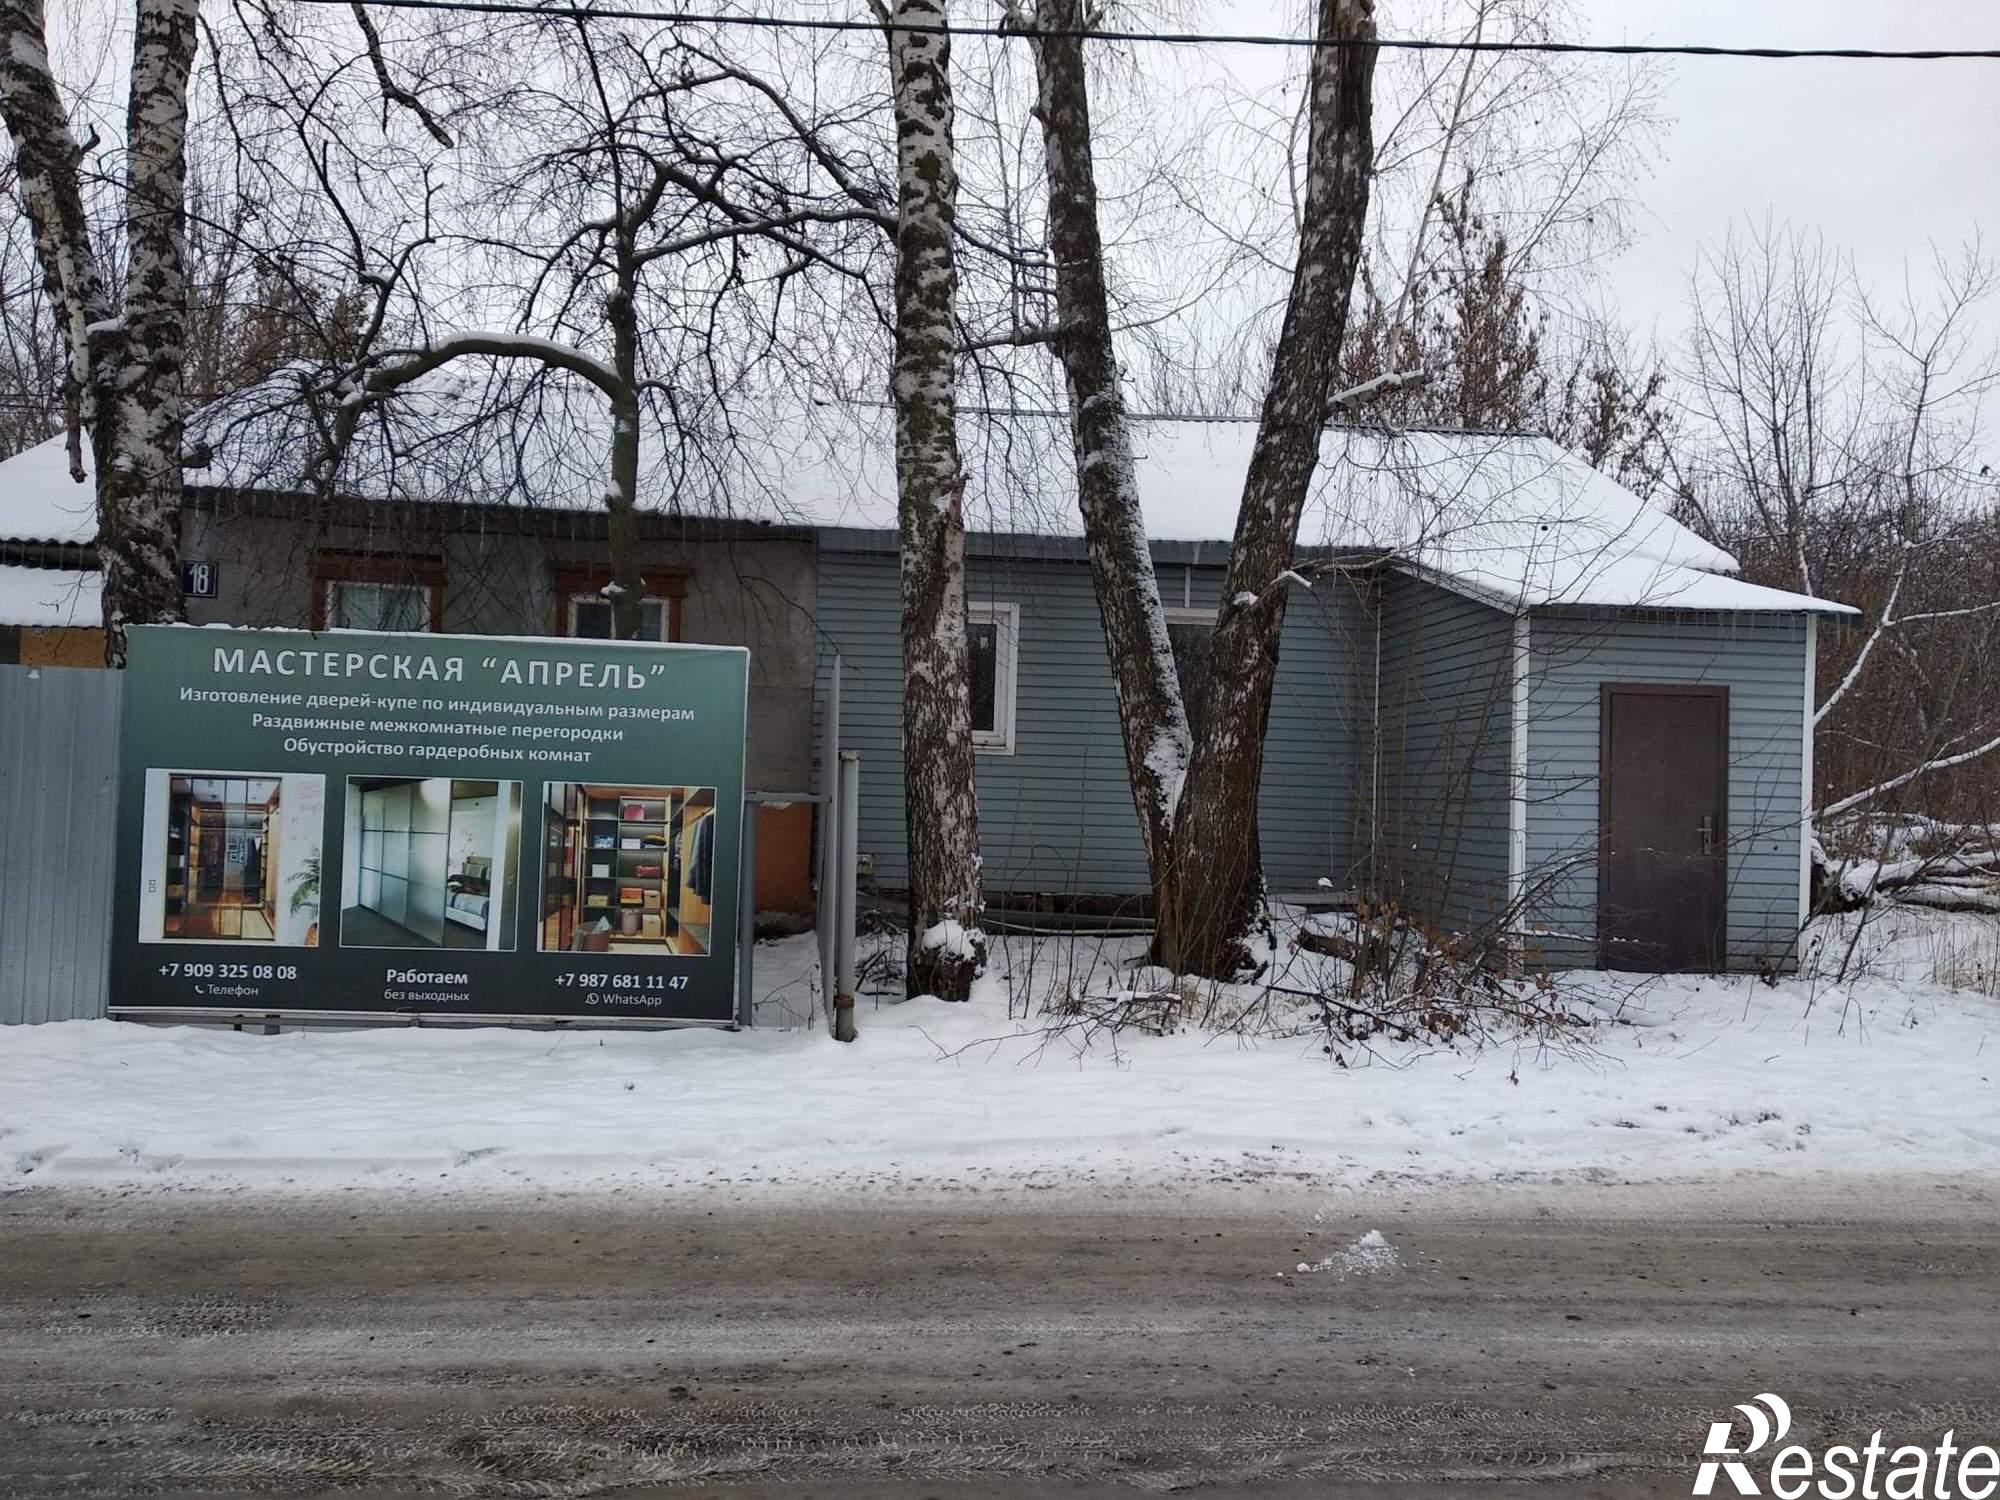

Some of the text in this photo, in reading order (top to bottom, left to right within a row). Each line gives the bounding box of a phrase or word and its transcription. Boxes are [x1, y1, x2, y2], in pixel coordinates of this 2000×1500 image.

[189, 563, 208, 593] 18
[213, 648, 463, 682] МАСТЕРСКАЯ
[180, 687, 695, 721] Изготовление дверей-купе по индивидуальным размерам
[252, 713, 623, 742] Раздвижные межкомнатные перегородки
[283, 738, 592, 763] Обустройство гардеробных комнат
[159, 963, 297, 980] +7 909 325 08 08
[386, 969, 469, 984] Работаем
[555, 973, 689, 990] +7 987 681 11 47
[207, 984, 259, 997] Телефон
[384, 988, 470, 1003] без выходных
[602, 993, 662, 1007] WhatsApp
